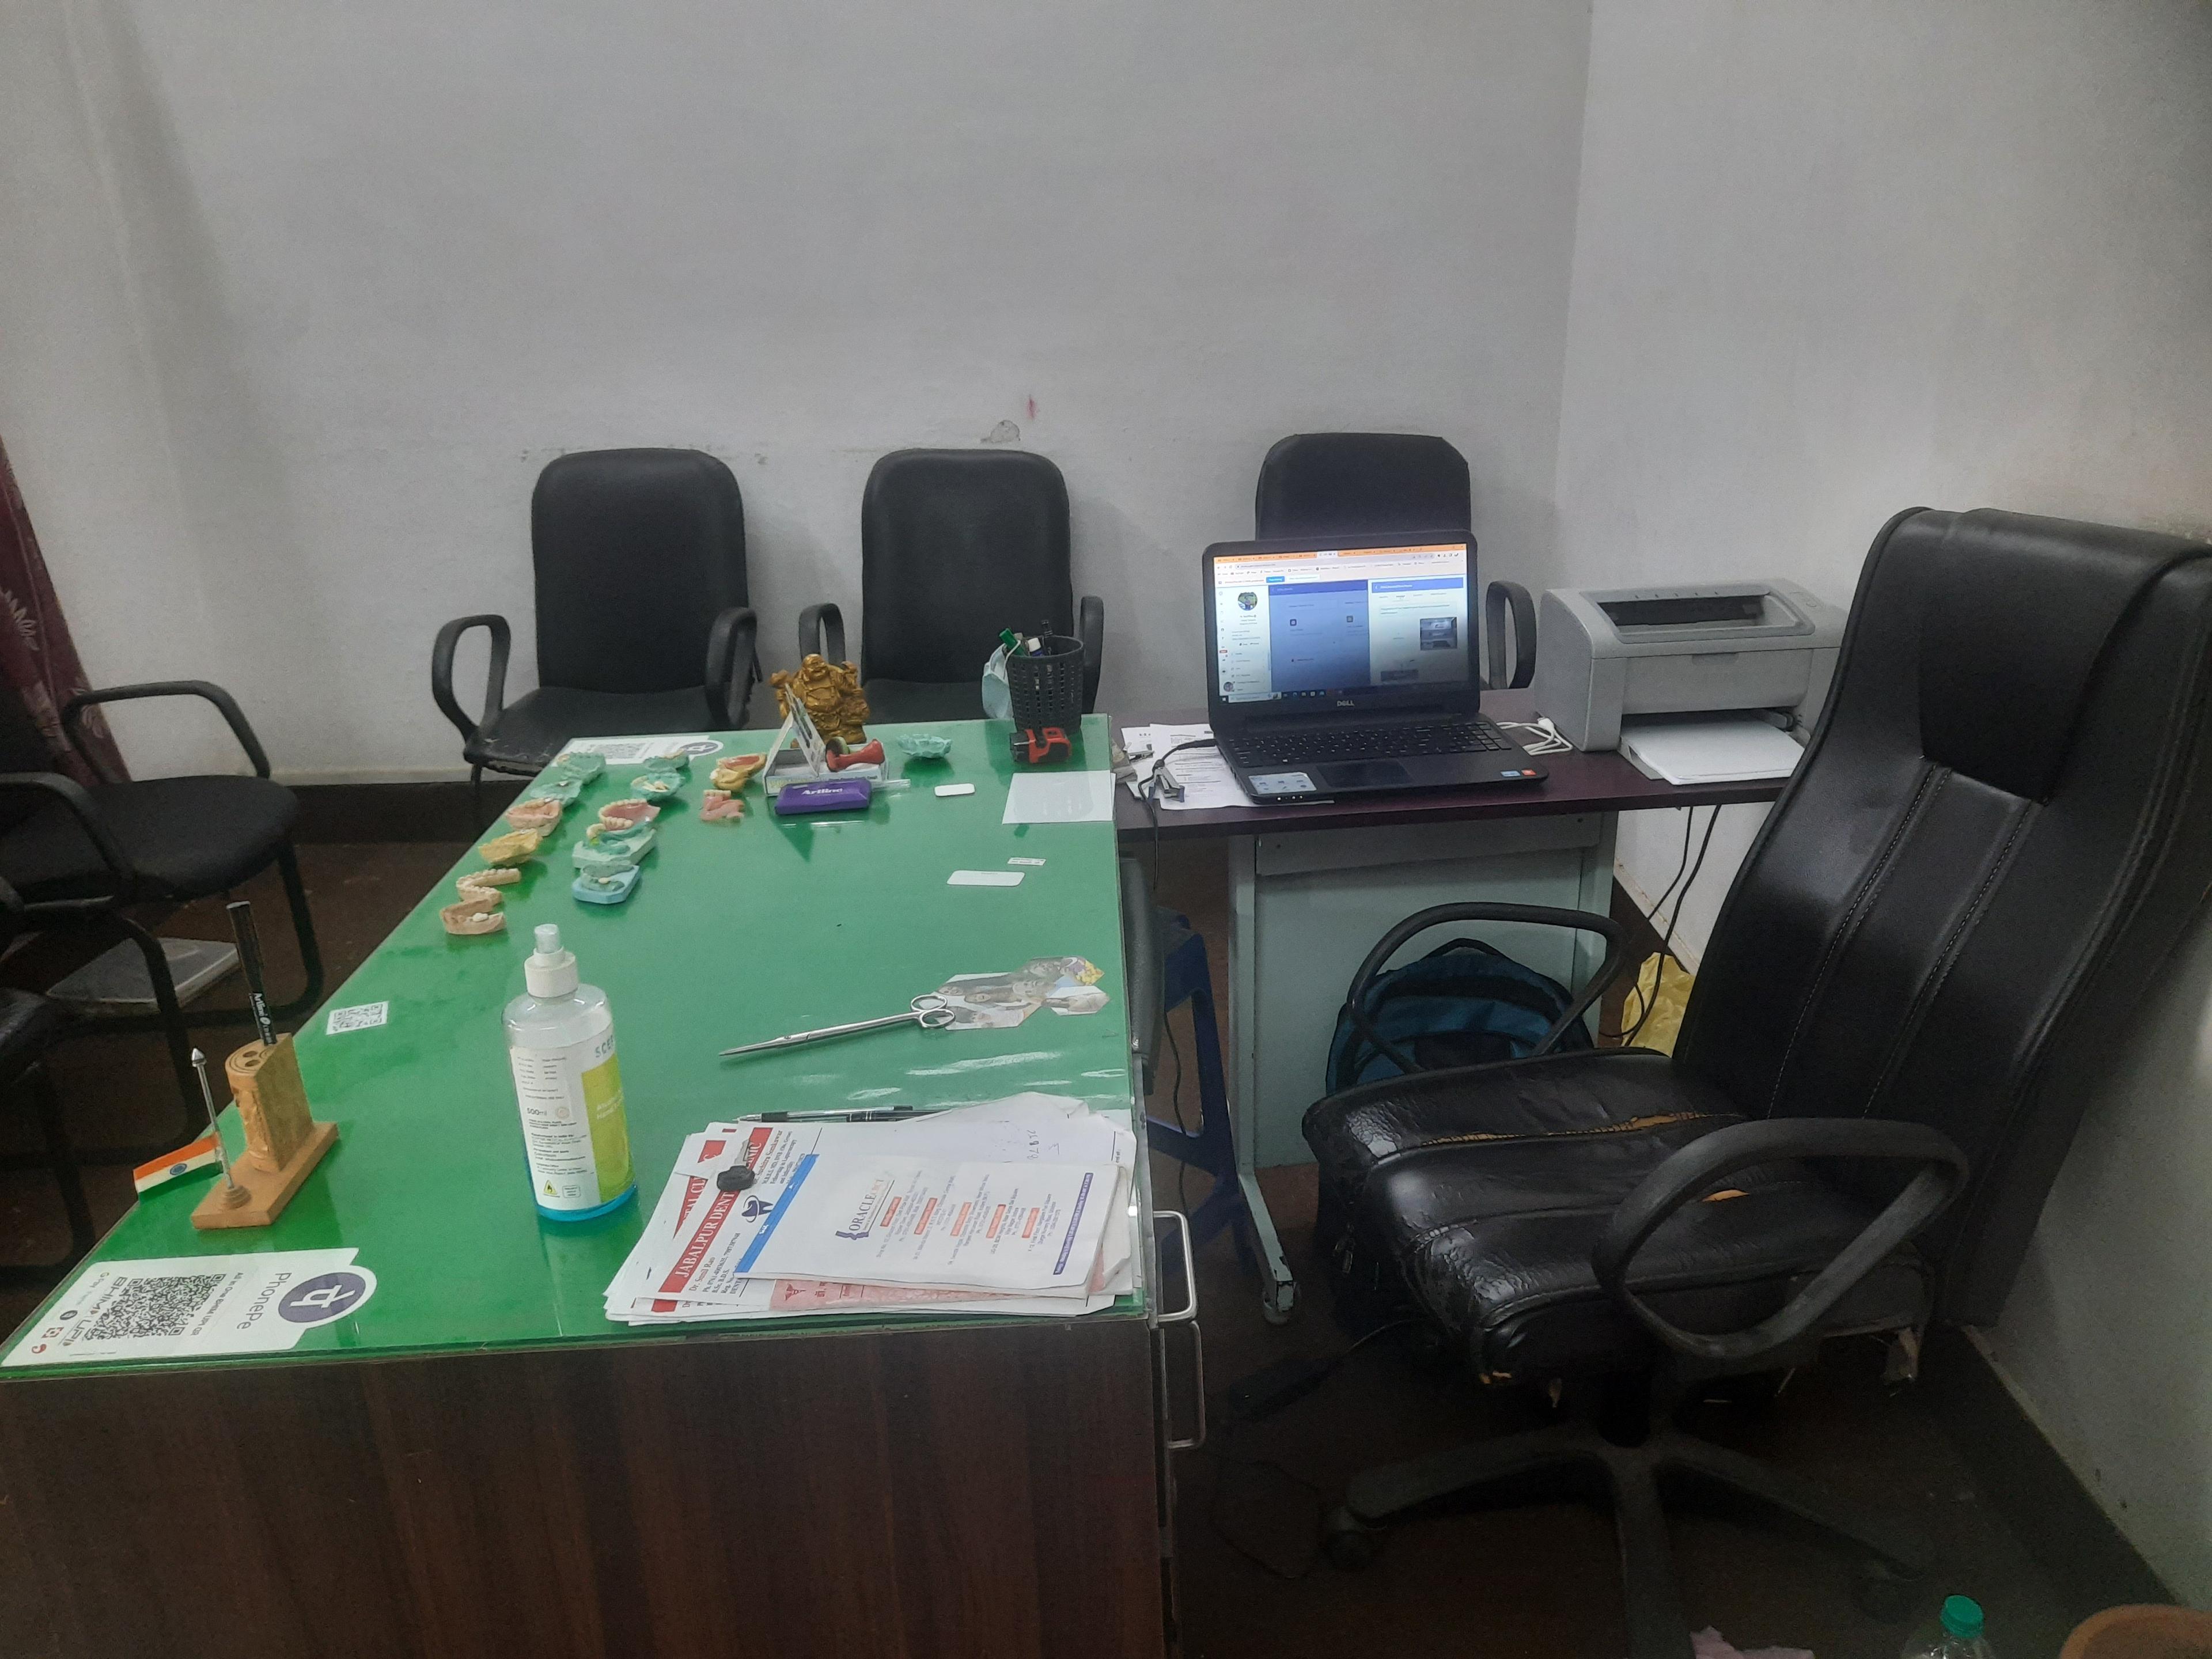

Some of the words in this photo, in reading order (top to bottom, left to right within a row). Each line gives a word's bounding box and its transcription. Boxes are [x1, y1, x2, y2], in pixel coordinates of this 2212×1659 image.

[675, 1221, 717, 1278] JABALPUR
[713, 1192, 736, 1222] DENT
[92, 1276, 128, 1310] BHIM
[218, 1286, 234, 1297] One
[236, 1272, 292, 1331] PhonePe
[65, 1319, 92, 1342] UPI
